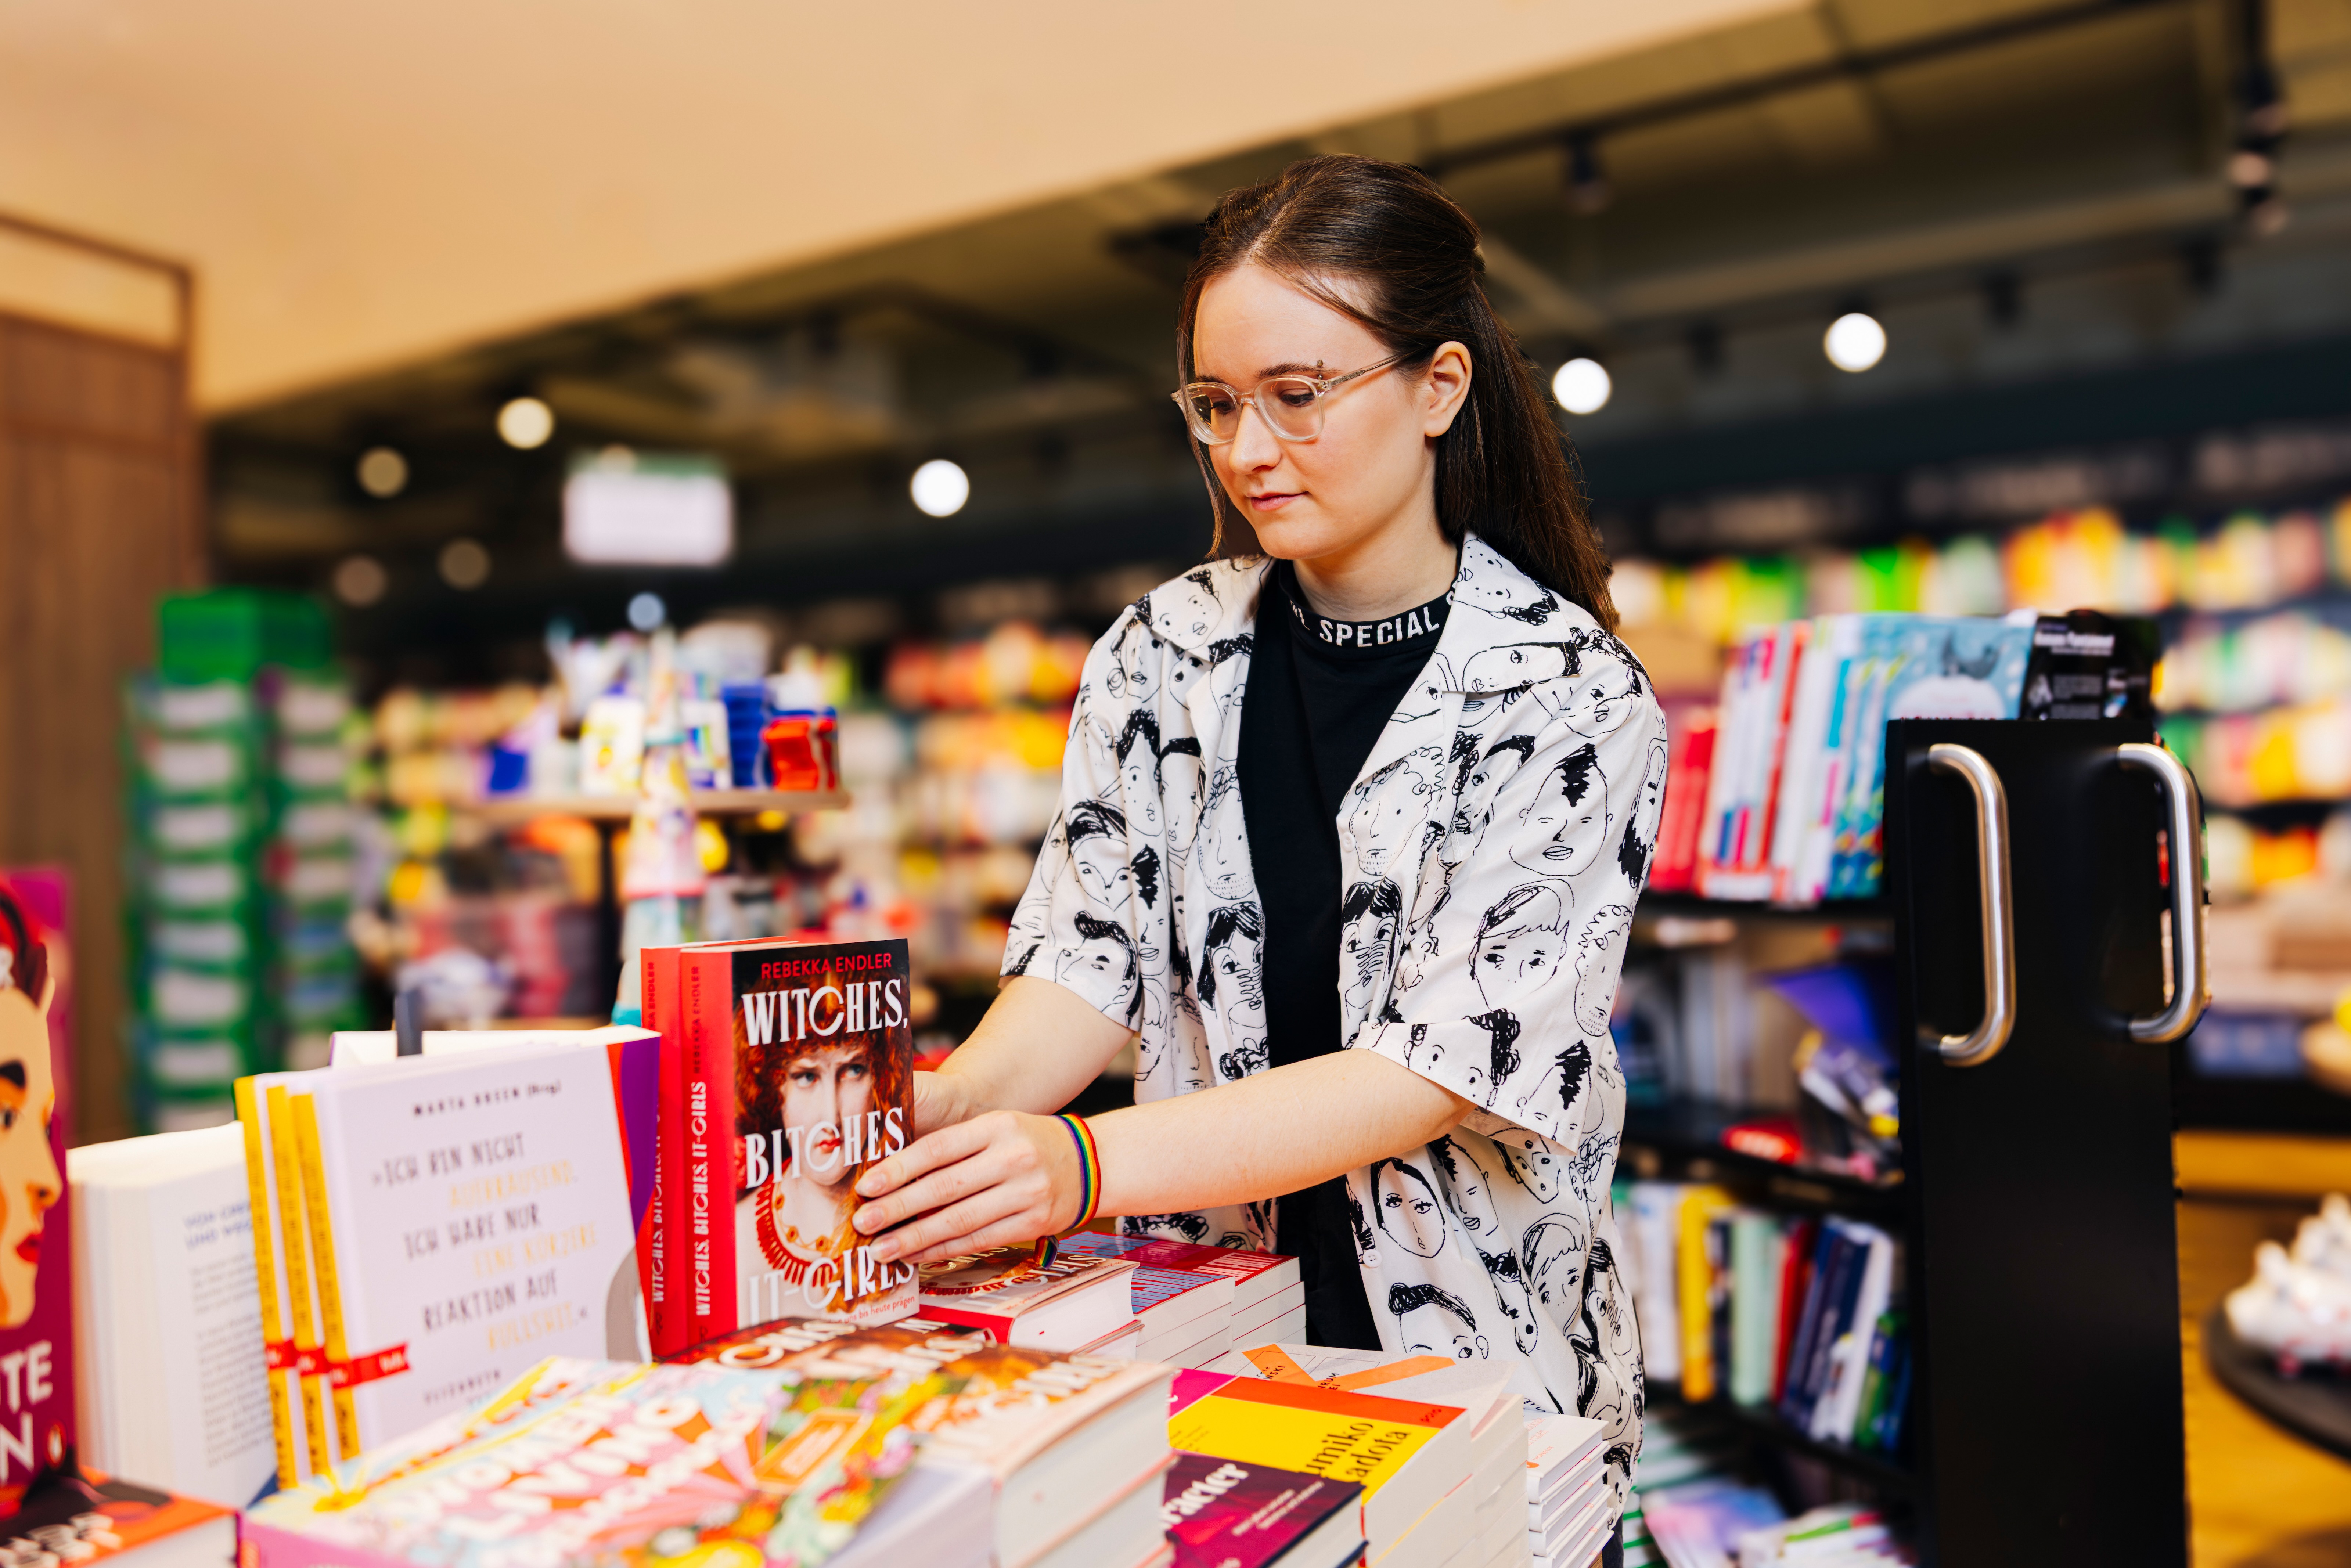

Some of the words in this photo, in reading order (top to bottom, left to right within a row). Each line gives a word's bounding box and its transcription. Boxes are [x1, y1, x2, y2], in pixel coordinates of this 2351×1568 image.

[1319, 606, 1440, 648] SPECIAL
[648, 962, 656, 1009] ENDLER
[761, 958, 832, 980] REBEKKA
[836, 952, 892, 973] ENDLER
[691, 966, 700, 1015] ENDLER
[741, 978, 908, 1047] WITCHES,
[692, 1018, 700, 1074] REBEKKA
[414, 1096, 464, 1118] MARTA
[691, 1081, 708, 1157] IT-GIRLS
[428, 1145, 462, 1176] BIN
[470, 1130, 524, 1167] NICHT
[692, 1161, 709, 1236] BITCHES,
[403, 1228, 439, 1262] ICH
[447, 1212, 494, 1246] HABE
[504, 1201, 540, 1232] NUR
[473, 1243, 515, 1279] EINE
[694, 1239, 710, 1316] WITCHES,
[422, 1282, 516, 1333] REAKTION
[526, 1269, 558, 1299] AUF
[858, 1309, 869, 1319] bis
[871, 1303, 890, 1315] heute
[892, 1295, 915, 1312] prägen
[1263, 1366, 1286, 1380] WSKI
[1306, 1423, 1373, 1477] umiko
[1346, 1431, 1411, 1477] adota
[1532, 1446, 1554, 1461] THORBECKE
